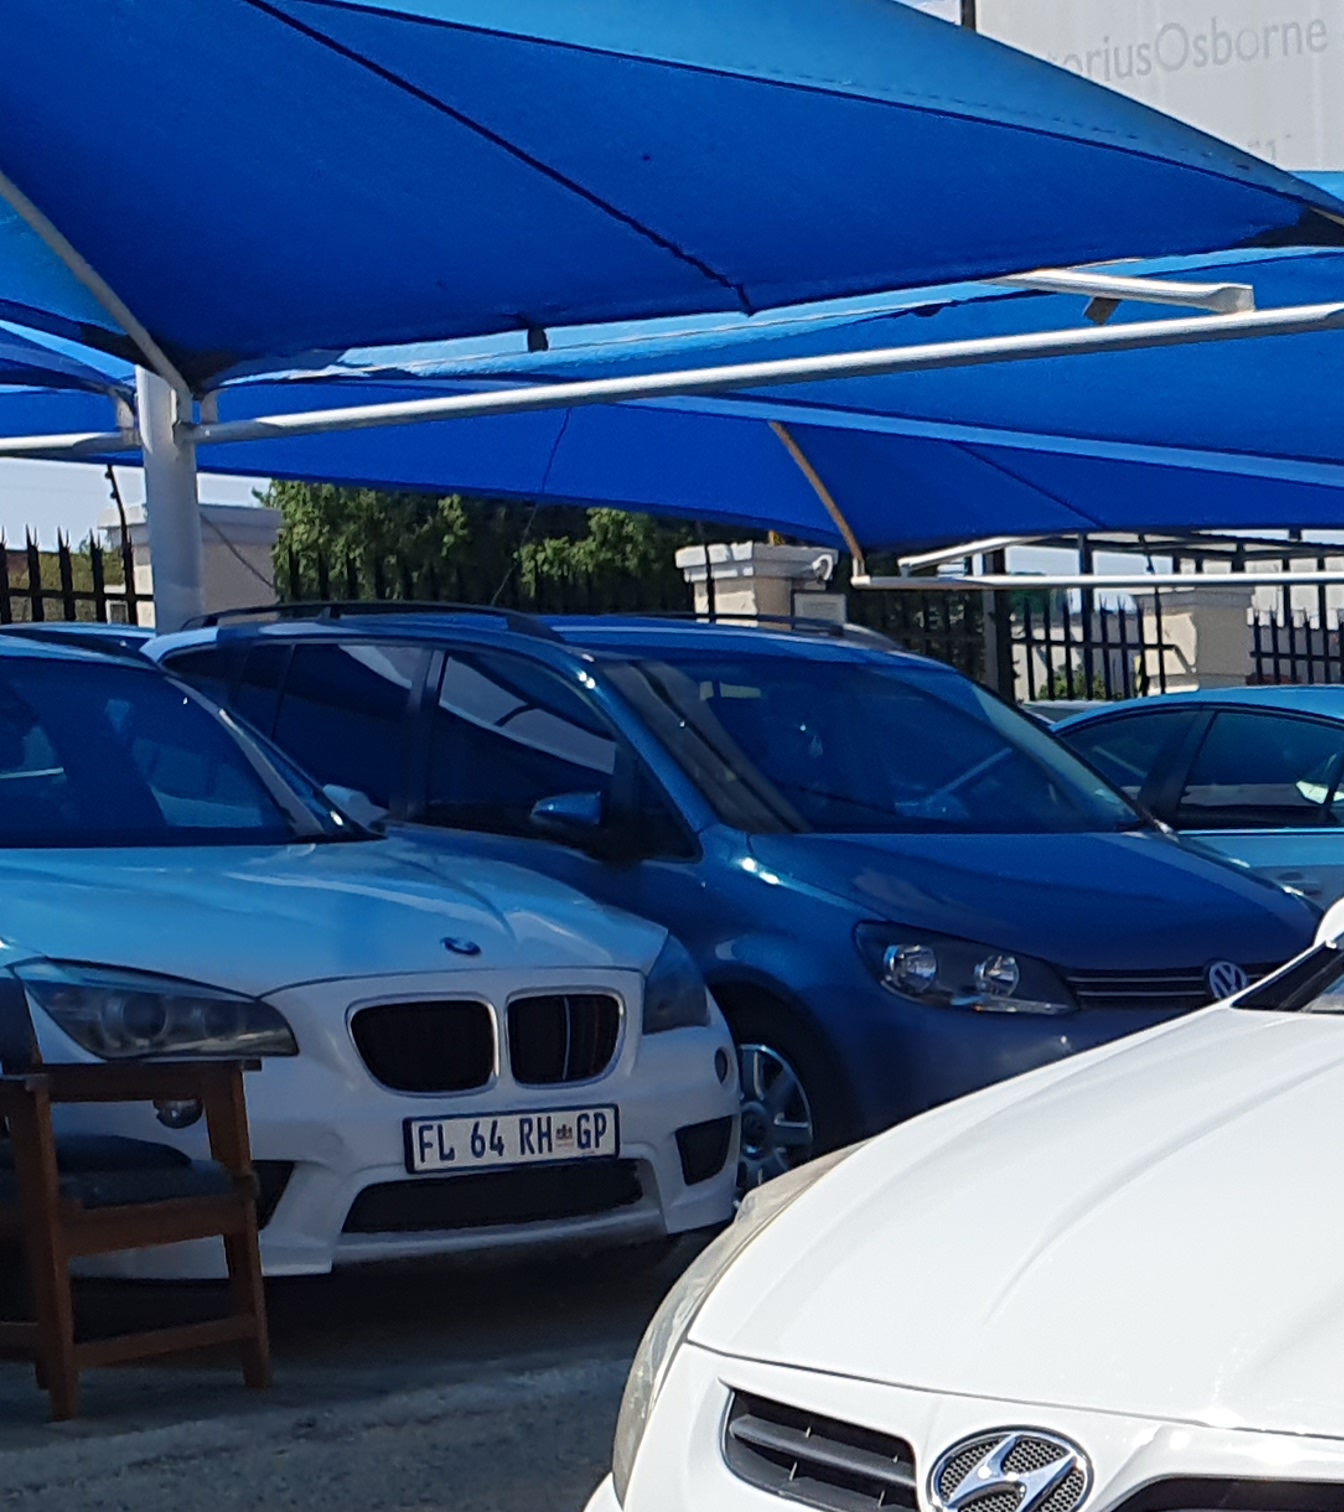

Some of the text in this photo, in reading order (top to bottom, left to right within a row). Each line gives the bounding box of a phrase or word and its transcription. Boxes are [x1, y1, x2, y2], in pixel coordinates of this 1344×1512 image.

[1053, 16, 1328, 80] oriusOsborne
[418, 1112, 607, 1163] FL 64 RH GP
